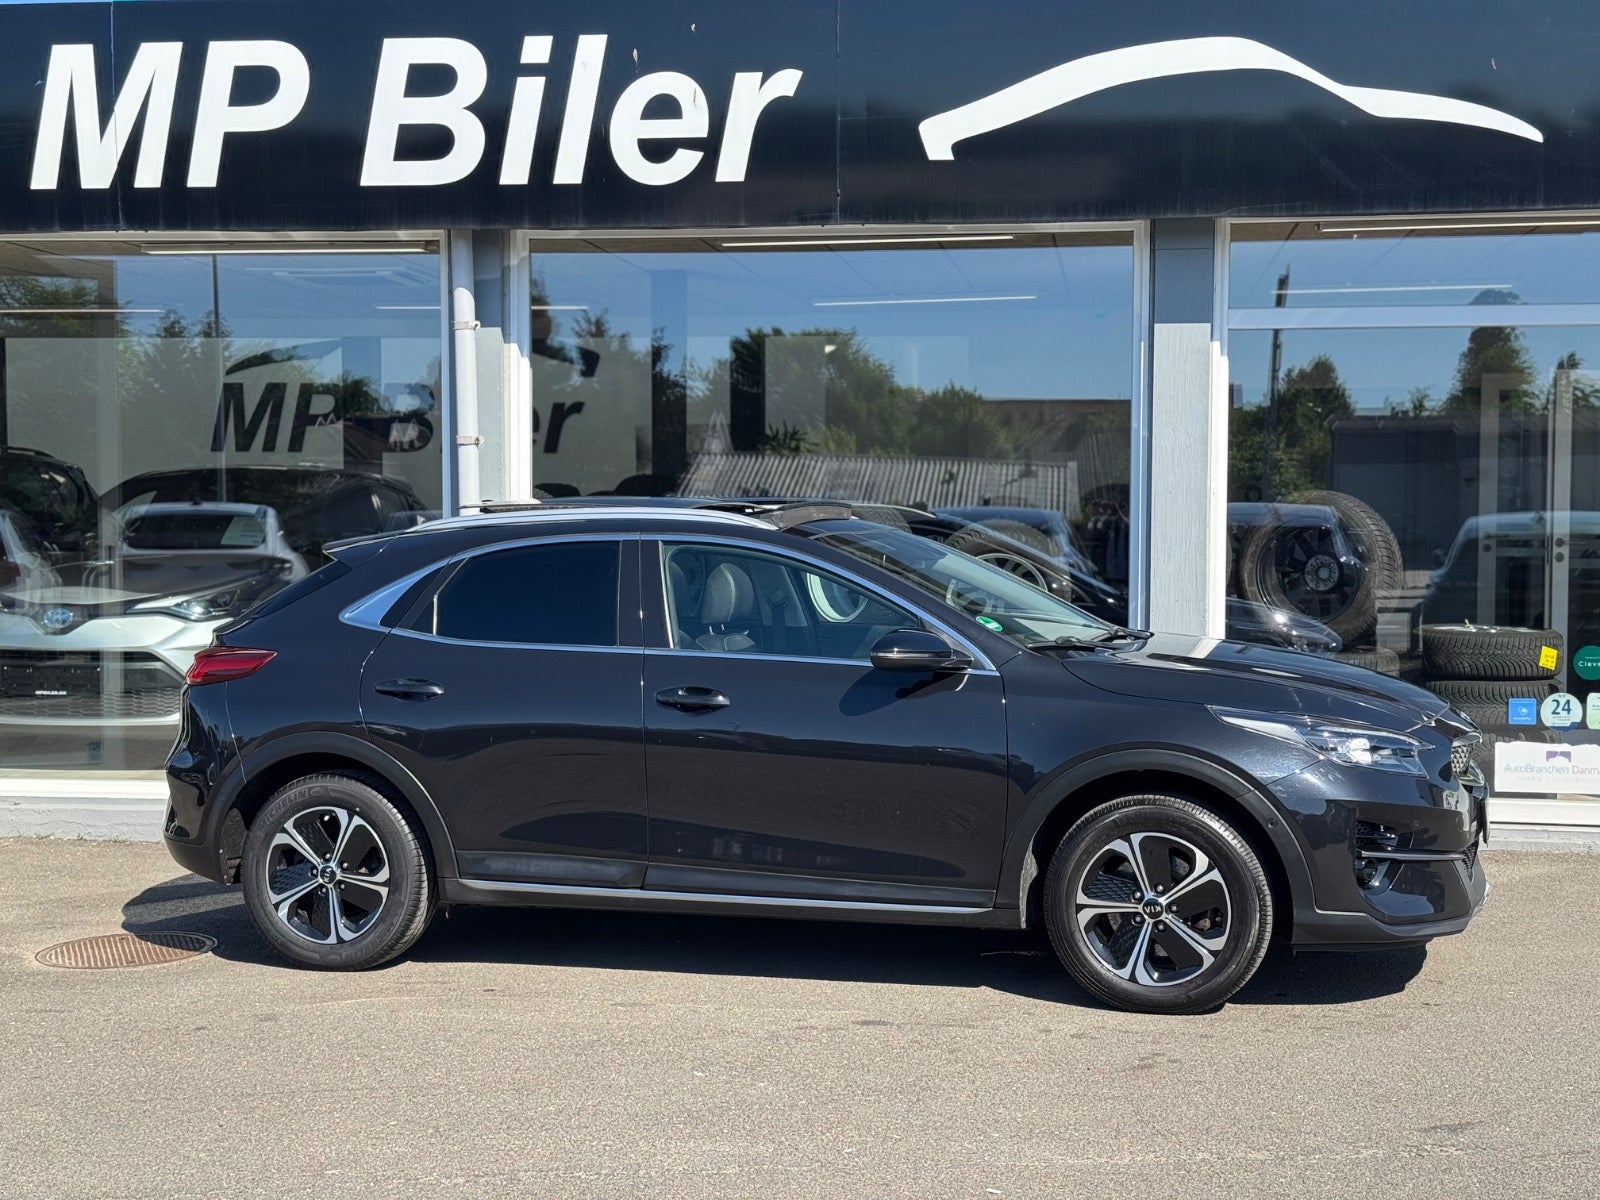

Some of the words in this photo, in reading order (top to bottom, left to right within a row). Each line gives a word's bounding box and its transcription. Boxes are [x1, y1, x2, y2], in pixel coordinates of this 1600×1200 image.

[30, 40, 310, 190] MP
[360, 34, 803, 187] Biler
[1551, 699, 1572, 715] 24
[1503, 763, 1570, 775] AutoBranchen
[1572, 765, 1600, 775] Danm
[323, 867, 333, 883] KIA
[1144, 905, 1162, 914] KIA
